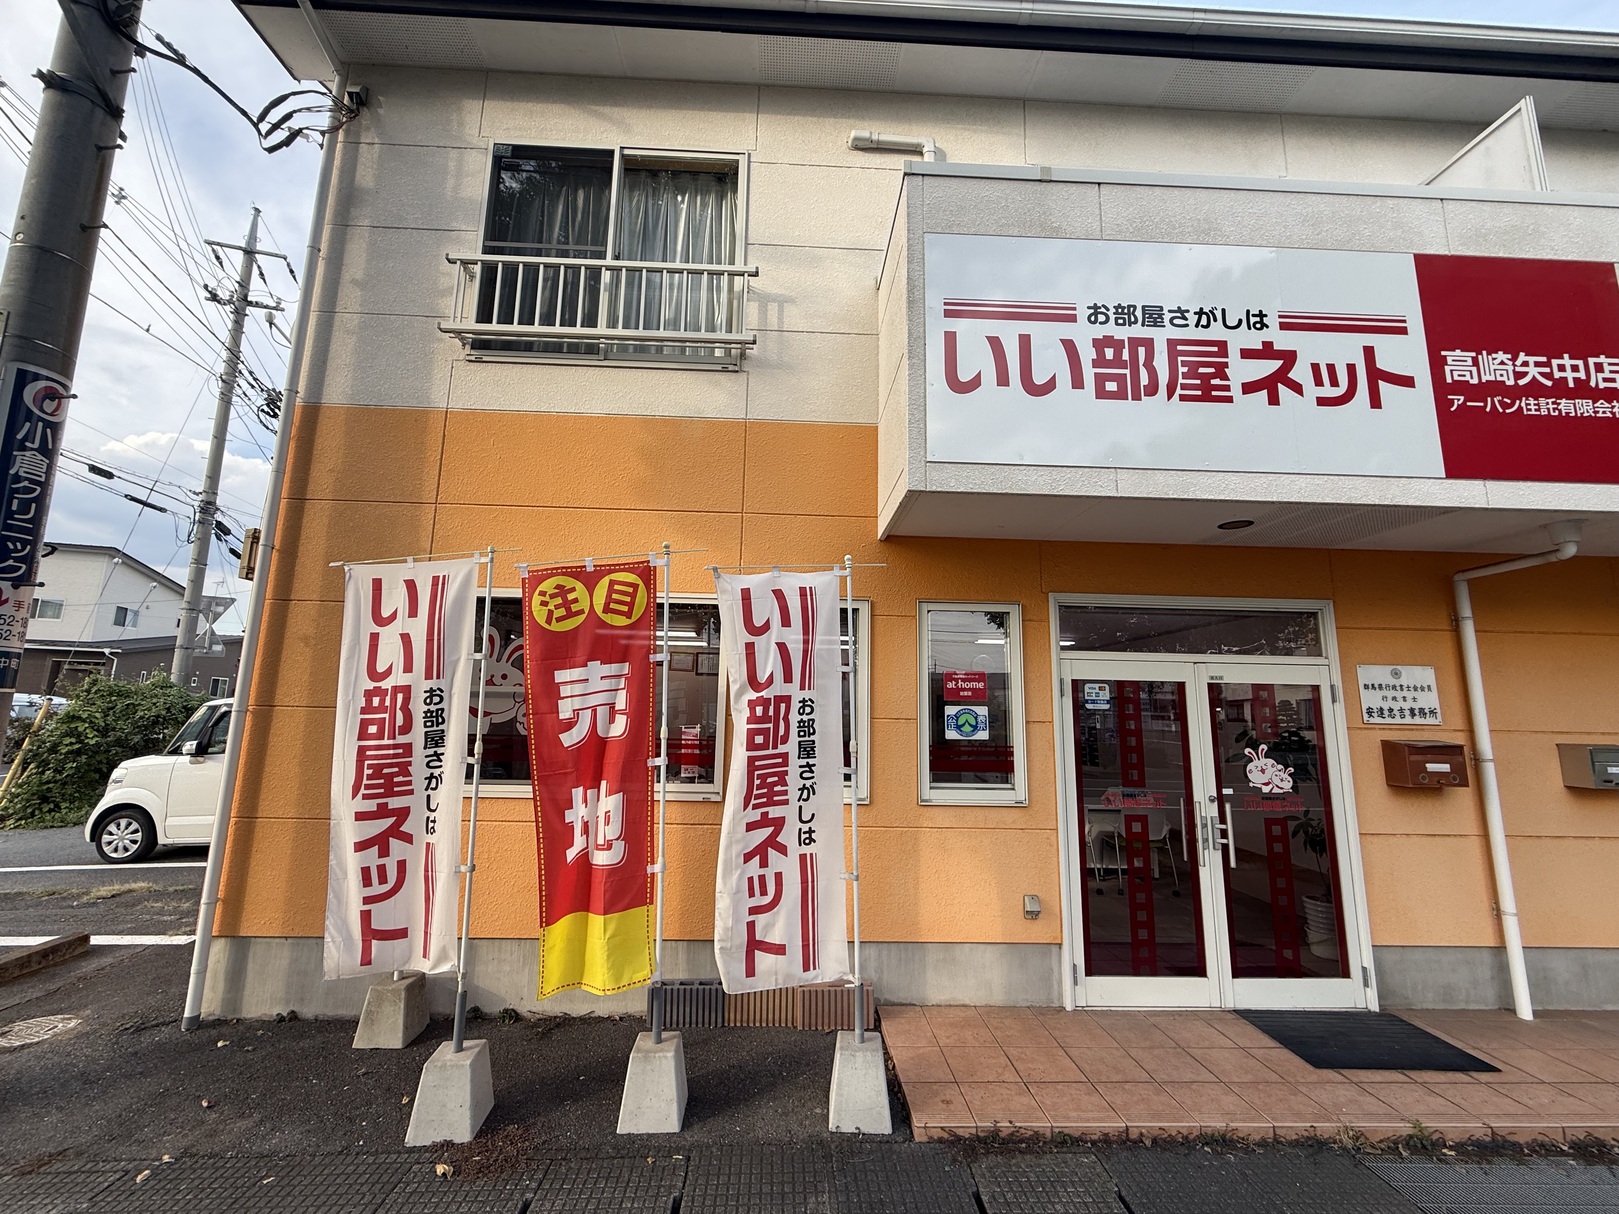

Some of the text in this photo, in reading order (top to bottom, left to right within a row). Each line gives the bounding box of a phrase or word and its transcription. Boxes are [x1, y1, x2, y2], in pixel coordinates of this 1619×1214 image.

[1087, 303, 1270, 331] お部屋さがしは
[943, 330, 1416, 410] いい部屋ネット
[1440, 349, 1619, 389] 高崎矢中店
[0, 421, 53, 578] 小倉クリニック
[538, 578, 640, 627] 注目
[1363, 683, 1433, 693] 群馬県行政書士会会員
[1365, 706, 1438, 720] 安達忠吉事務所
[1382, 695, 1418, 703] 行政書士
[351, 577, 418, 966] いい部屋ネット
[422, 686, 446, 836] お部屋さがしは
[554, 660, 632, 868] 売地
[741, 587, 793, 978] いい部屋ネット
[796, 697, 816, 847] お部屋さがしは
